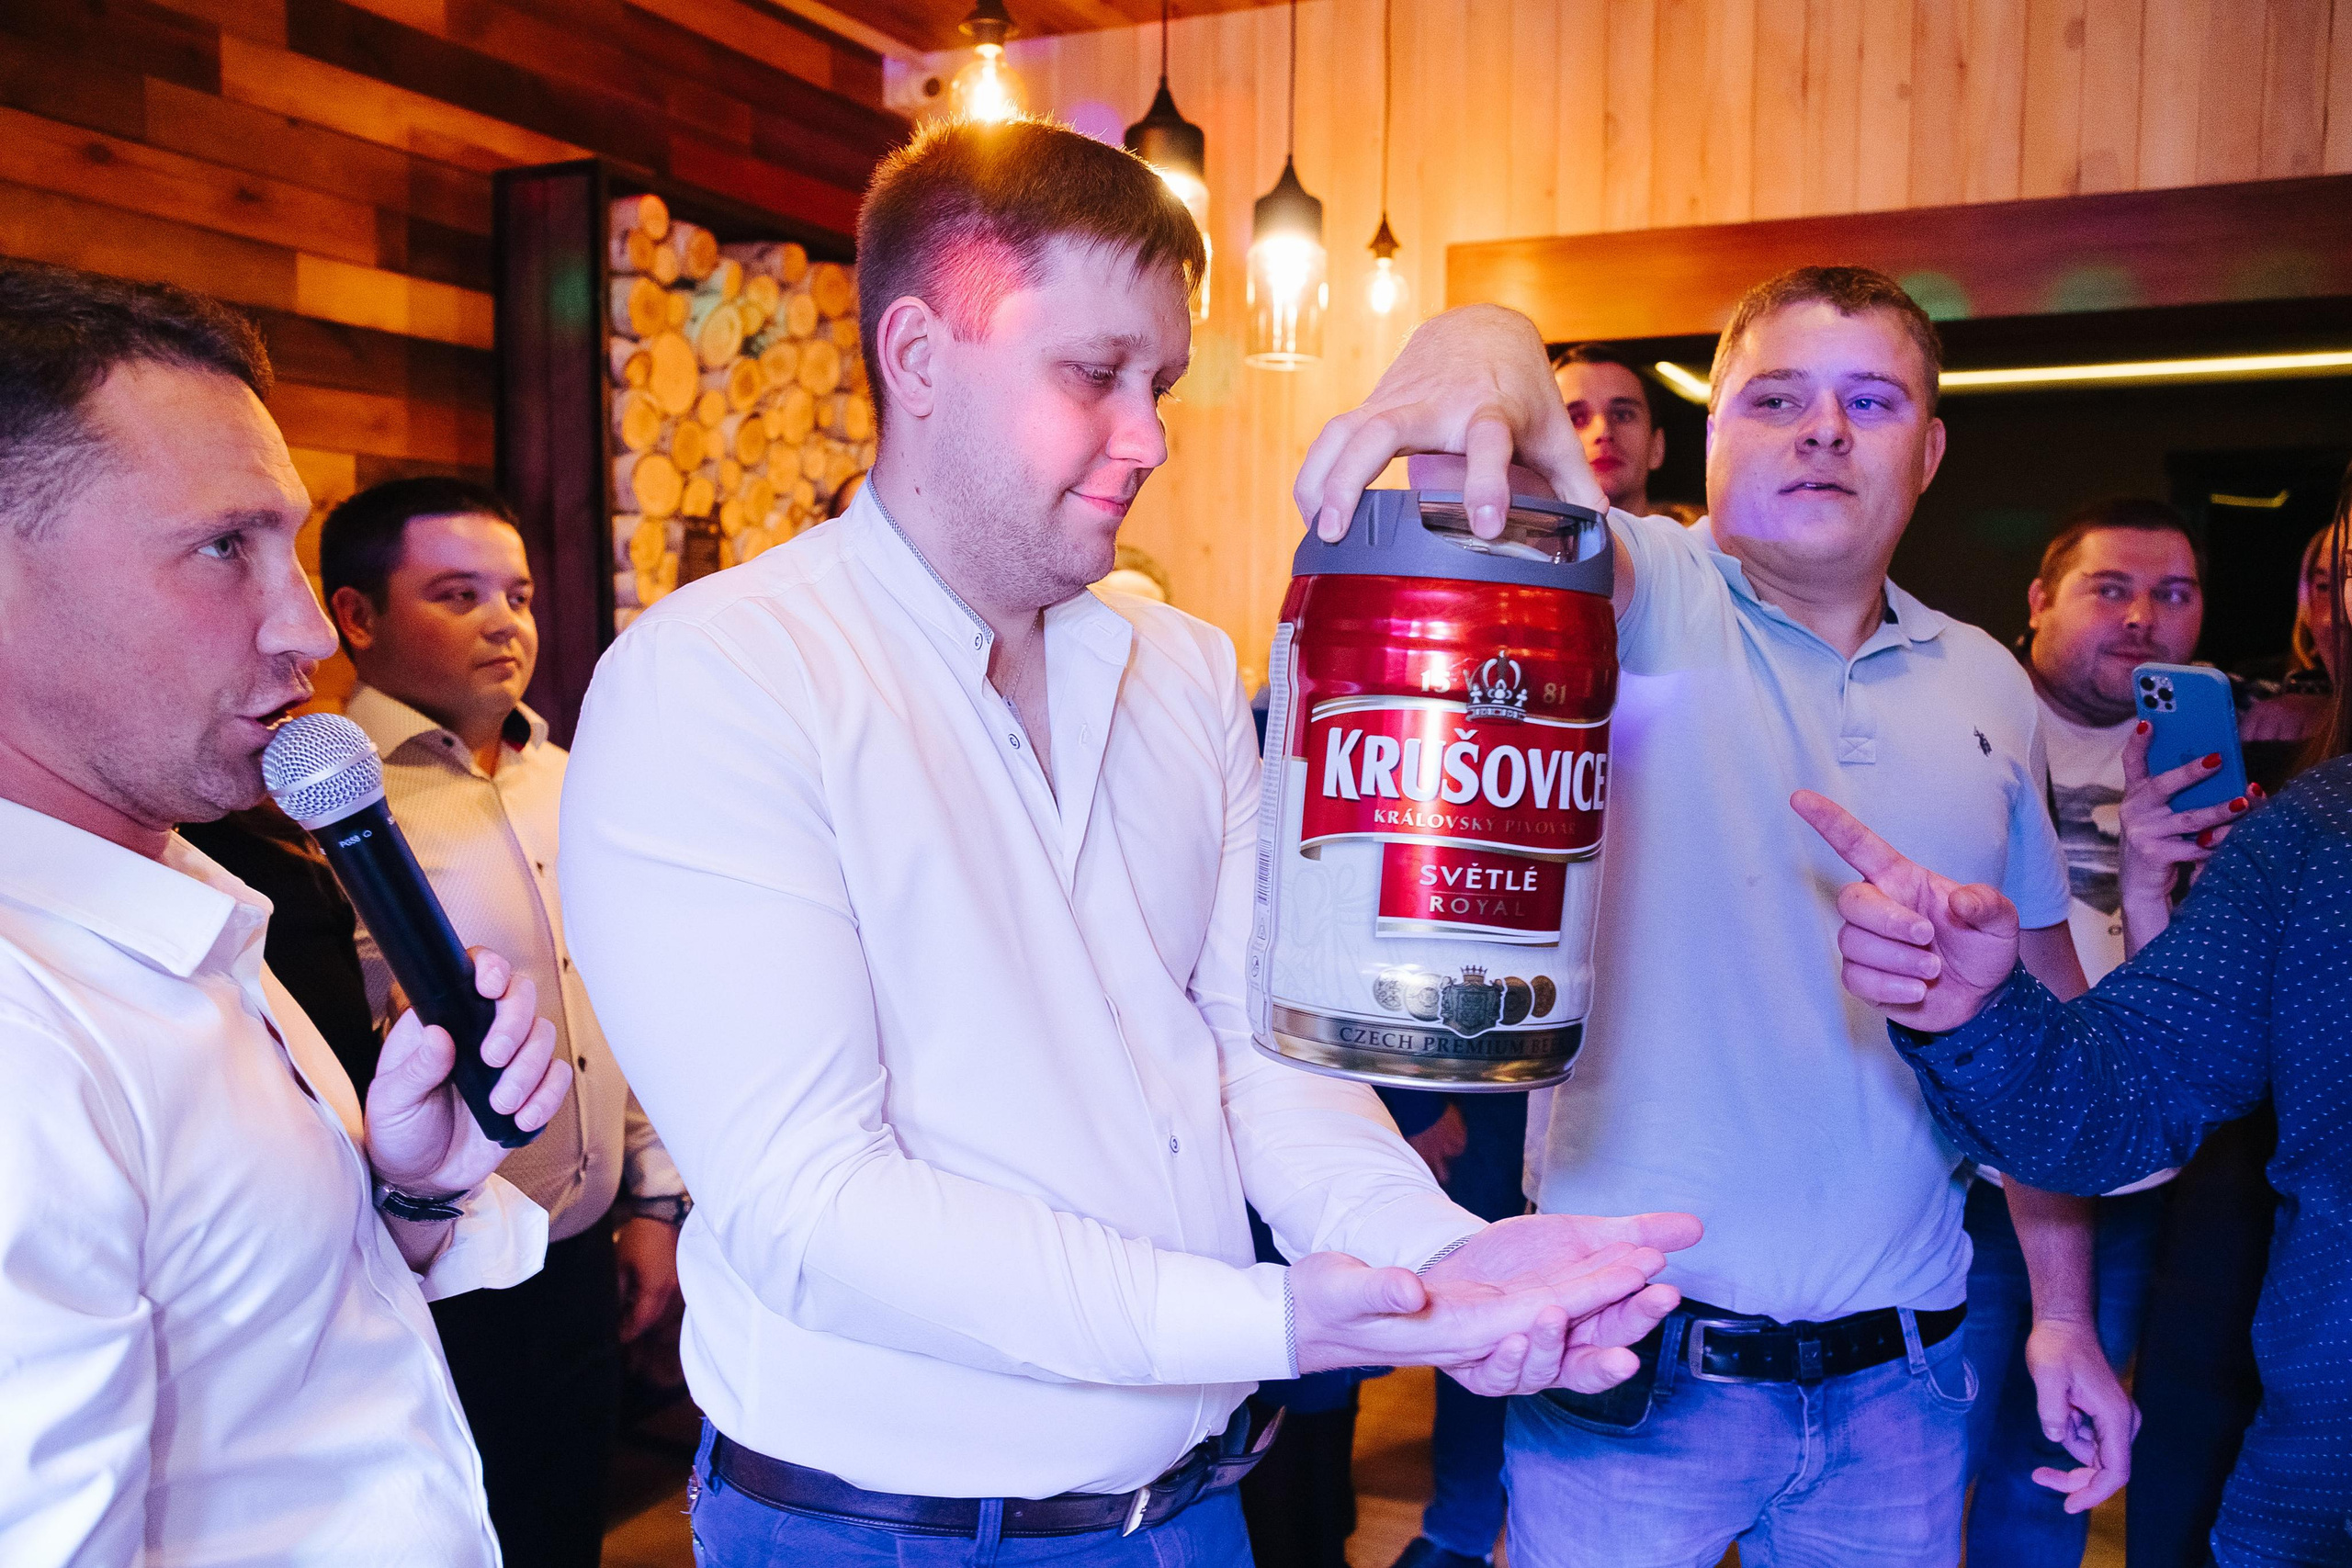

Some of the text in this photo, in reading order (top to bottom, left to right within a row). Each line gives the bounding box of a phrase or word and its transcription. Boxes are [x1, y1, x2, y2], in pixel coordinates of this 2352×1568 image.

[1420, 670, 1567, 705] 15 81
[1322, 727, 1607, 812] KRUŠOVICE
[1374, 808, 1495, 832] KRÁLOVSKÝ
[1419, 863, 1539, 892] SVĚTLÉ
[1429, 896, 1526, 917] ROYAL
[1339, 1026, 1413, 1051] CZECH
[1423, 1036, 1525, 1056] PREMIUM
